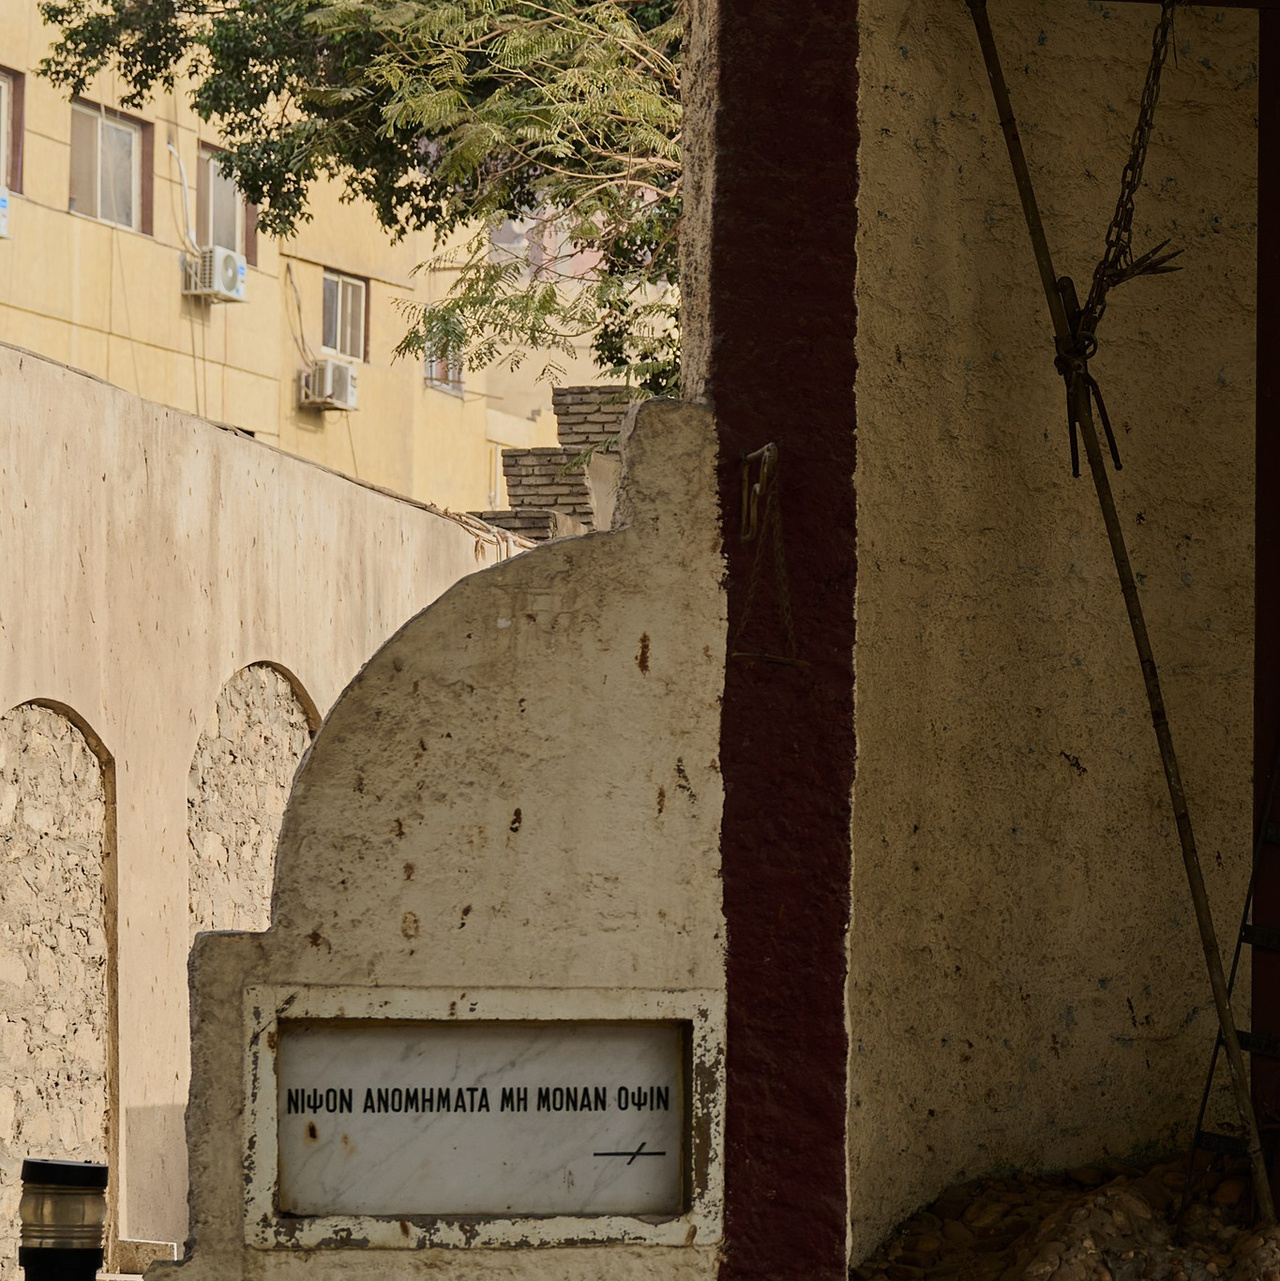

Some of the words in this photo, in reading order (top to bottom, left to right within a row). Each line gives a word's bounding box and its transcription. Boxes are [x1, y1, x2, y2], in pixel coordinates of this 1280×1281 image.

[286, 1088, 353, 1114] ΝΙΨΟΝ
[363, 1087, 490, 1113] ΑΝΟΜΗΜΑΤΑ
[500, 1087, 528, 1112] ΜΗ
[537, 1086, 607, 1112] ΜΟΝΑΝ
[617, 1086, 670, 1111] ΟΨΙΝ
